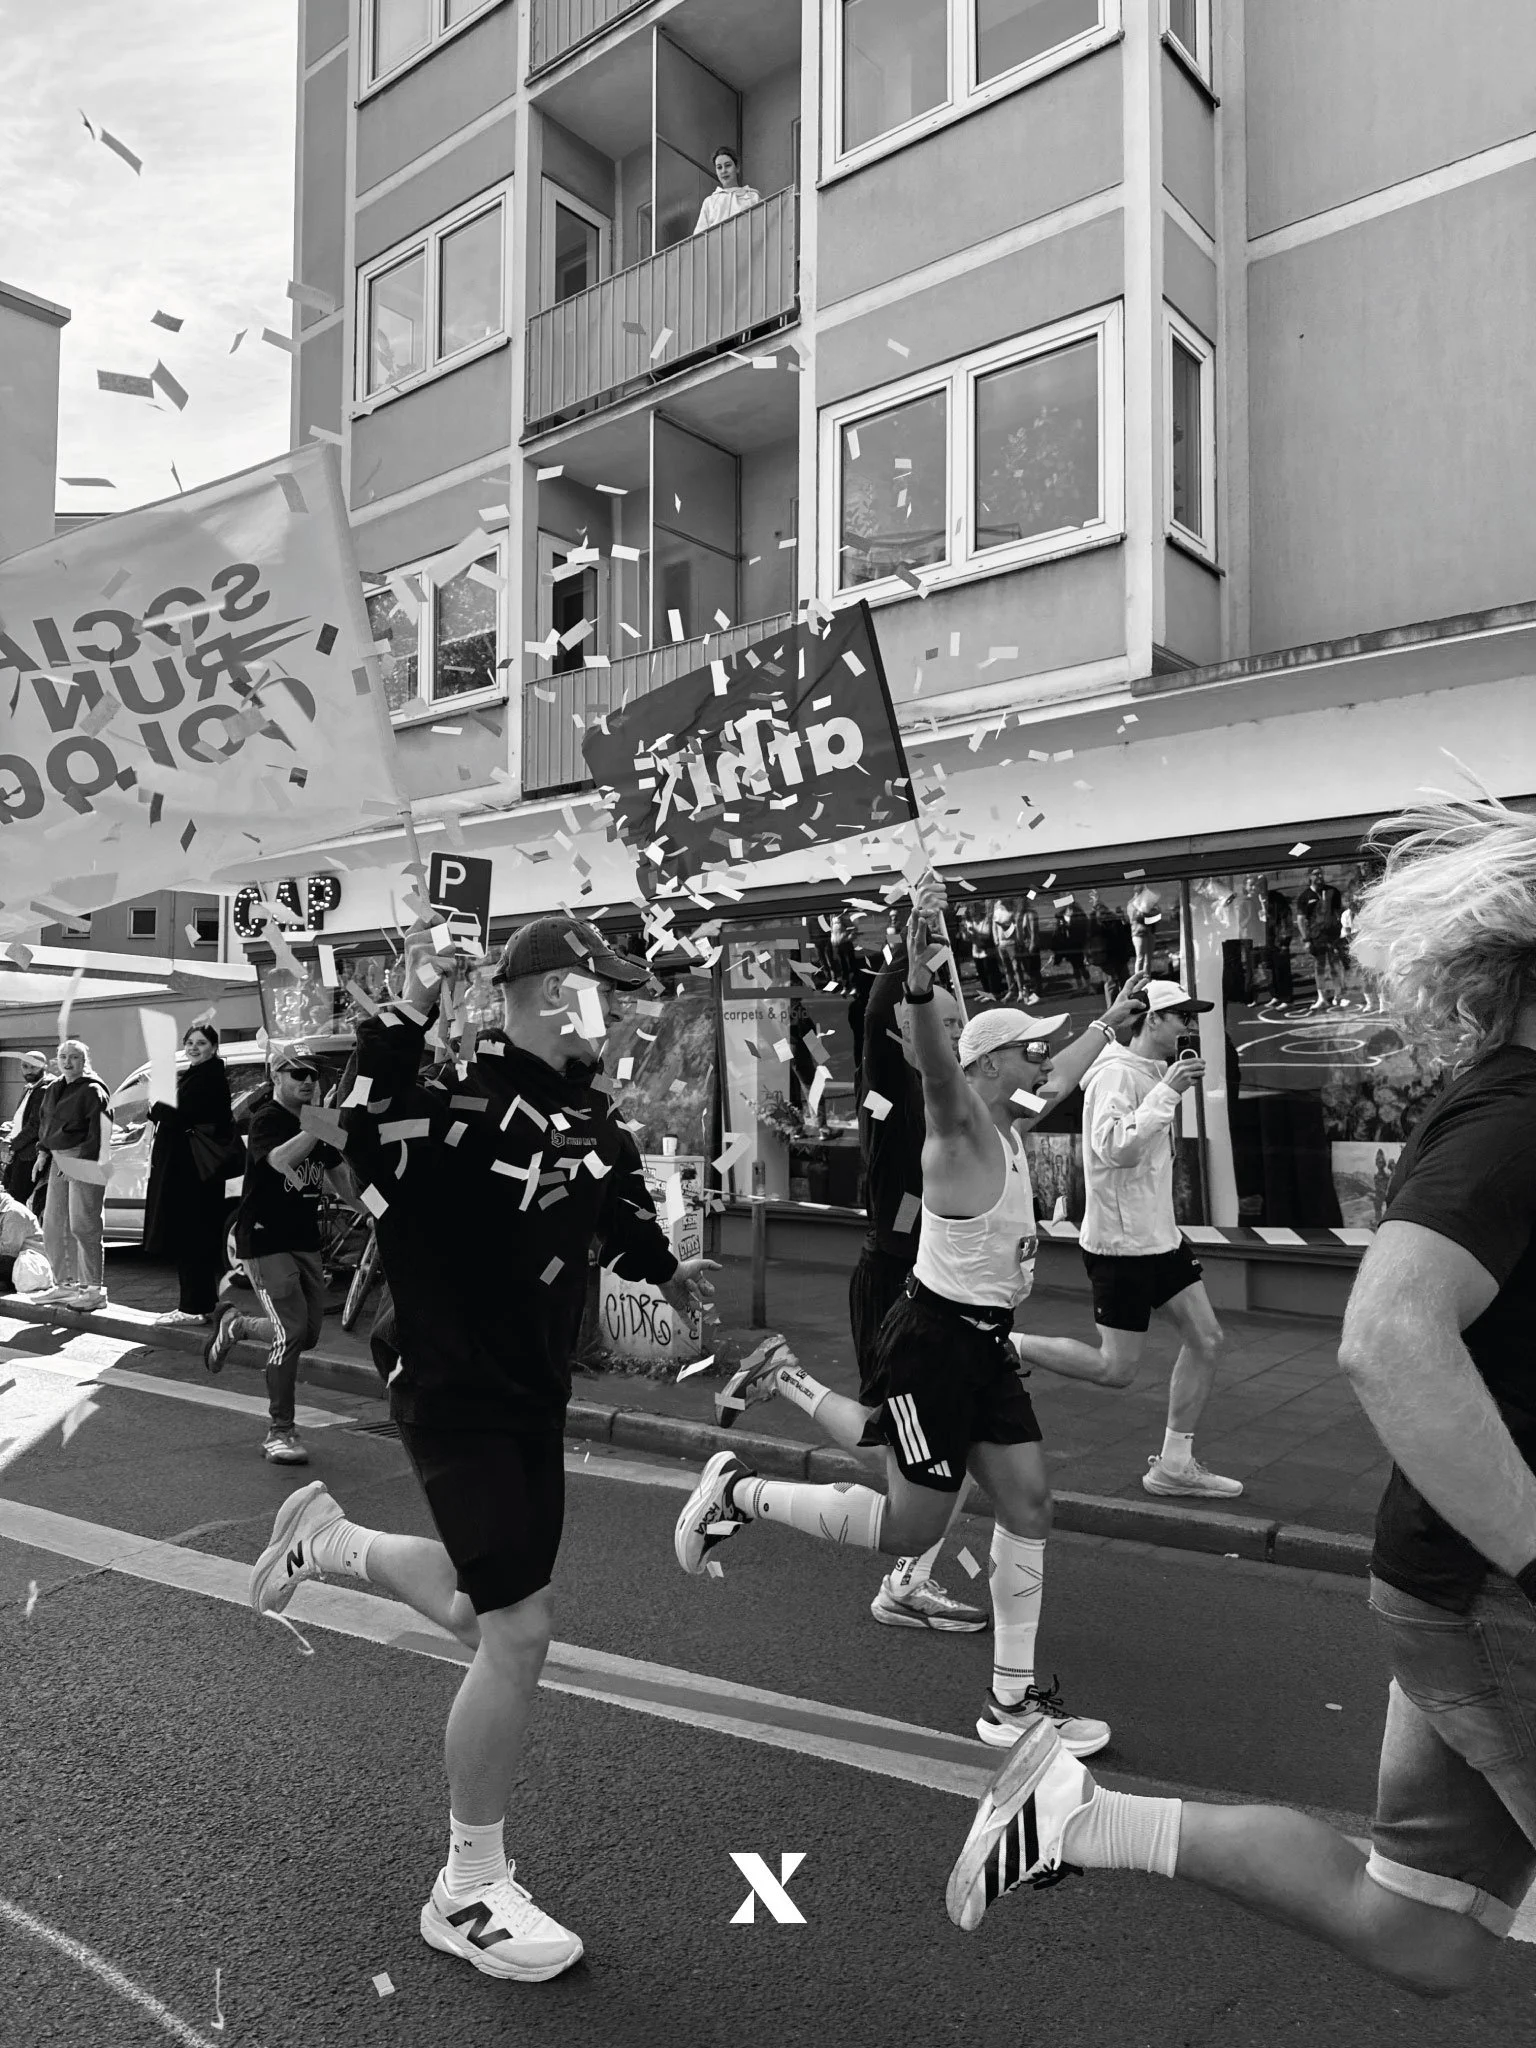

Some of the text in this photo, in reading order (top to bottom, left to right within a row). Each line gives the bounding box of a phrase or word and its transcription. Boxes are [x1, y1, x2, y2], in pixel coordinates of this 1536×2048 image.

[439, 859, 467, 899] P
[723, 1009, 763, 1023] carpets
[767, 1007, 775, 1020] &
[446, 1901, 513, 1950] N
